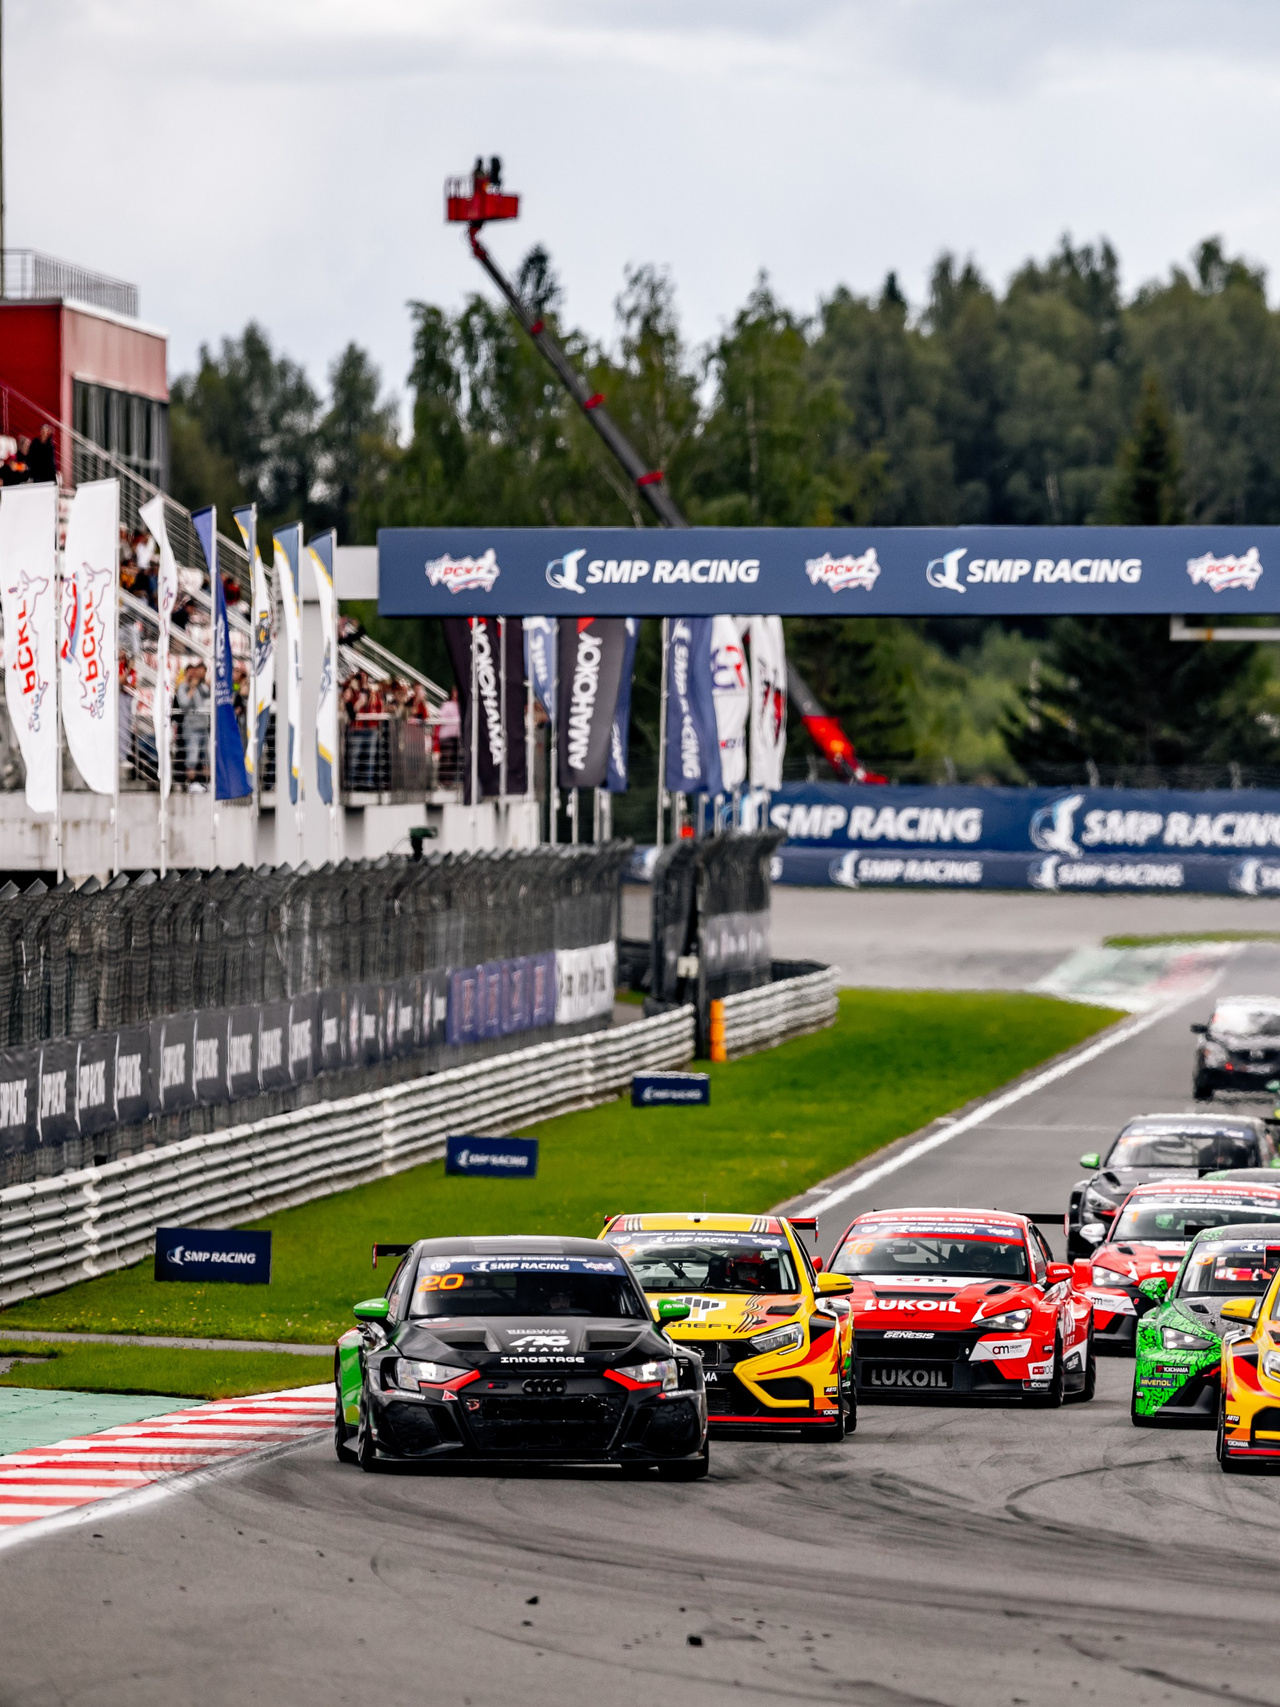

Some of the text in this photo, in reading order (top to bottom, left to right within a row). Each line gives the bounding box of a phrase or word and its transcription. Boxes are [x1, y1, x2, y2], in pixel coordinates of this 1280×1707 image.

[586, 559, 760, 584] SMP RACING
[967, 558, 1142, 583] SMP RACING
[472, 623, 505, 766] YOKOHAMA
[770, 804, 983, 844] SMP RACING
[1082, 809, 1161, 847] SMP
[857, 858, 983, 883] SMP RACING
[468, 1152, 529, 1166] SMP RACING
[936, 1226, 976, 1234] RACING
[987, 1219, 1018, 1227] TEAM
[694, 1236, 739, 1244] RACING
[845, 1242, 876, 1255] 16
[183, 1250, 257, 1265] SMP RACING
[489, 1262, 570, 1272] SMP RACING
[416, 1273, 465, 1293] 20
[864, 1299, 961, 1313] LUKOIL
[883, 1330, 935, 1339] GENESIS
[992, 1344, 1010, 1355] am
[871, 1369, 948, 1387] LUKOIL
